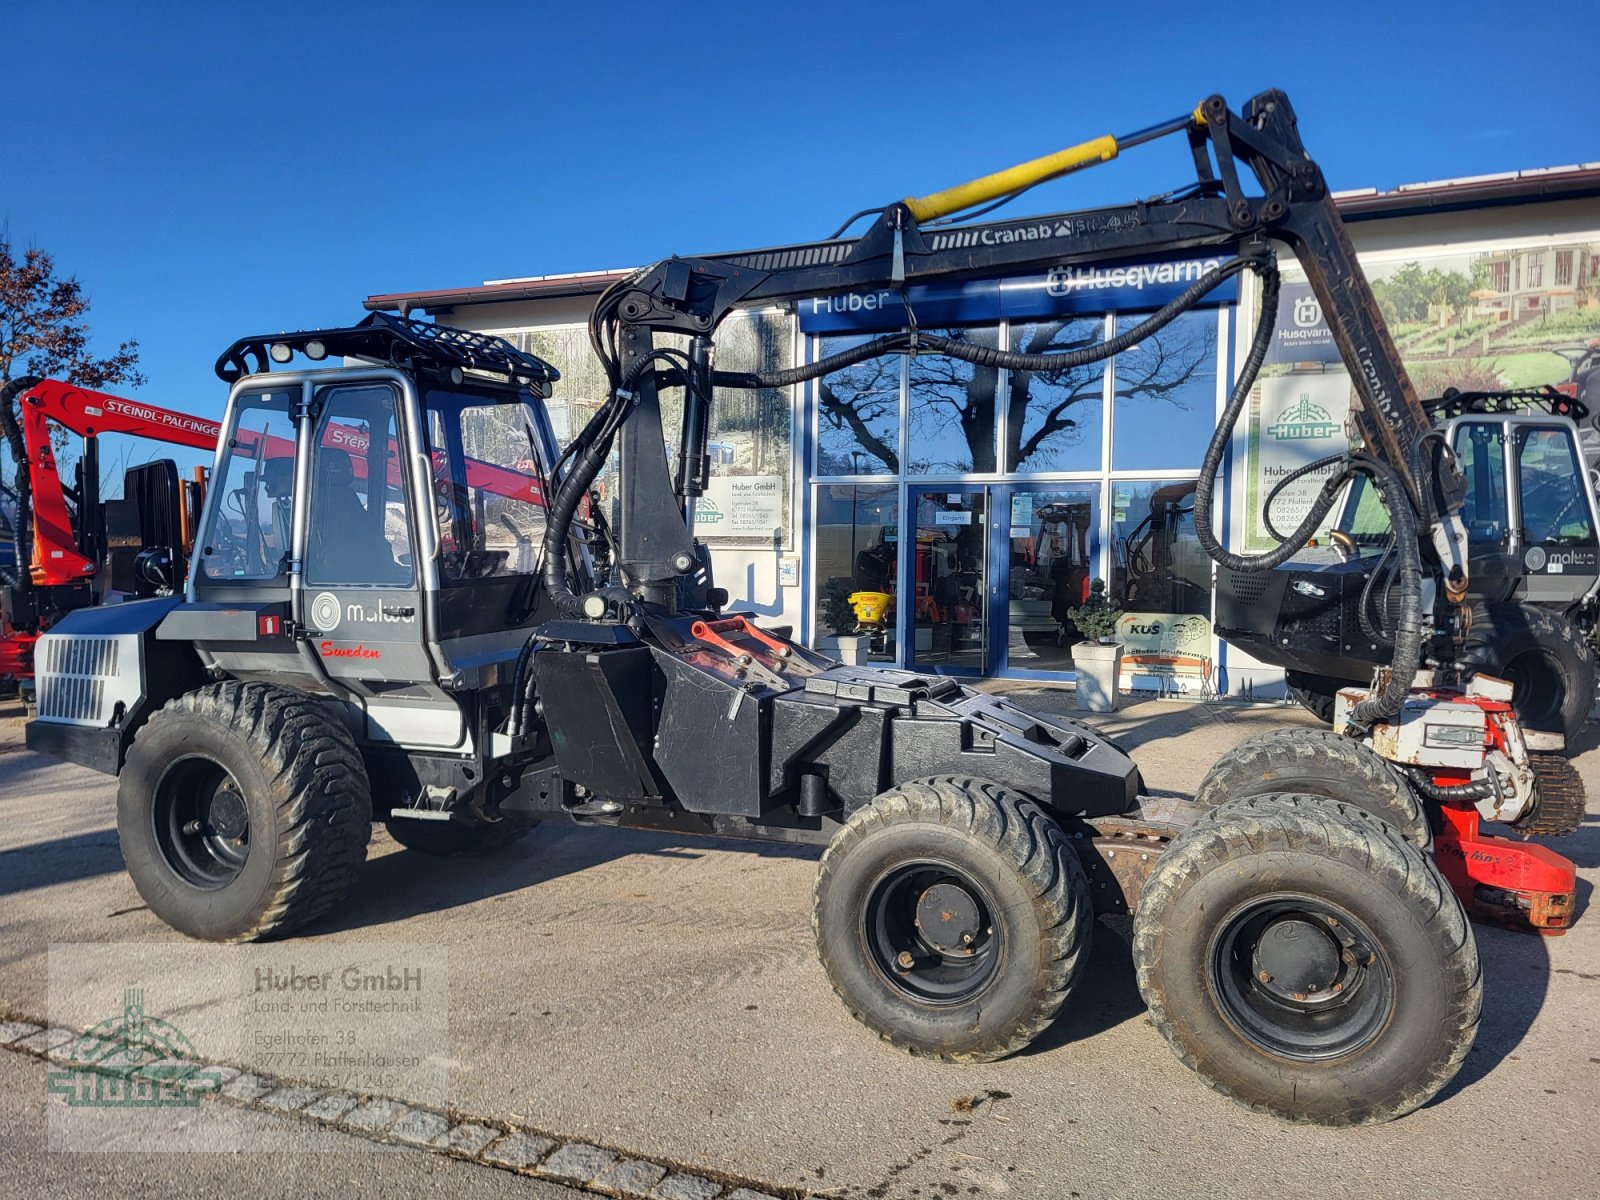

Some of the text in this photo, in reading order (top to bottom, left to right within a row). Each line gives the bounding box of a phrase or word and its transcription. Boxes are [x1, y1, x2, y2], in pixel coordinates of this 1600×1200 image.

[981, 224, 1052, 246] Cranab
[1075, 258, 1220, 291] Husqvarna
[813, 292, 890, 315] Huber
[1279, 328, 1332, 340] Husqvarn
[107, 400, 222, 437] STEINDL-PALFINGE
[1269, 424, 1339, 438] Huber
[732, 482, 776, 491] Huber GmbH
[695, 512, 722, 522] uber
[1550, 548, 1595, 565] malwa
[320, 641, 381, 658] Sweden
